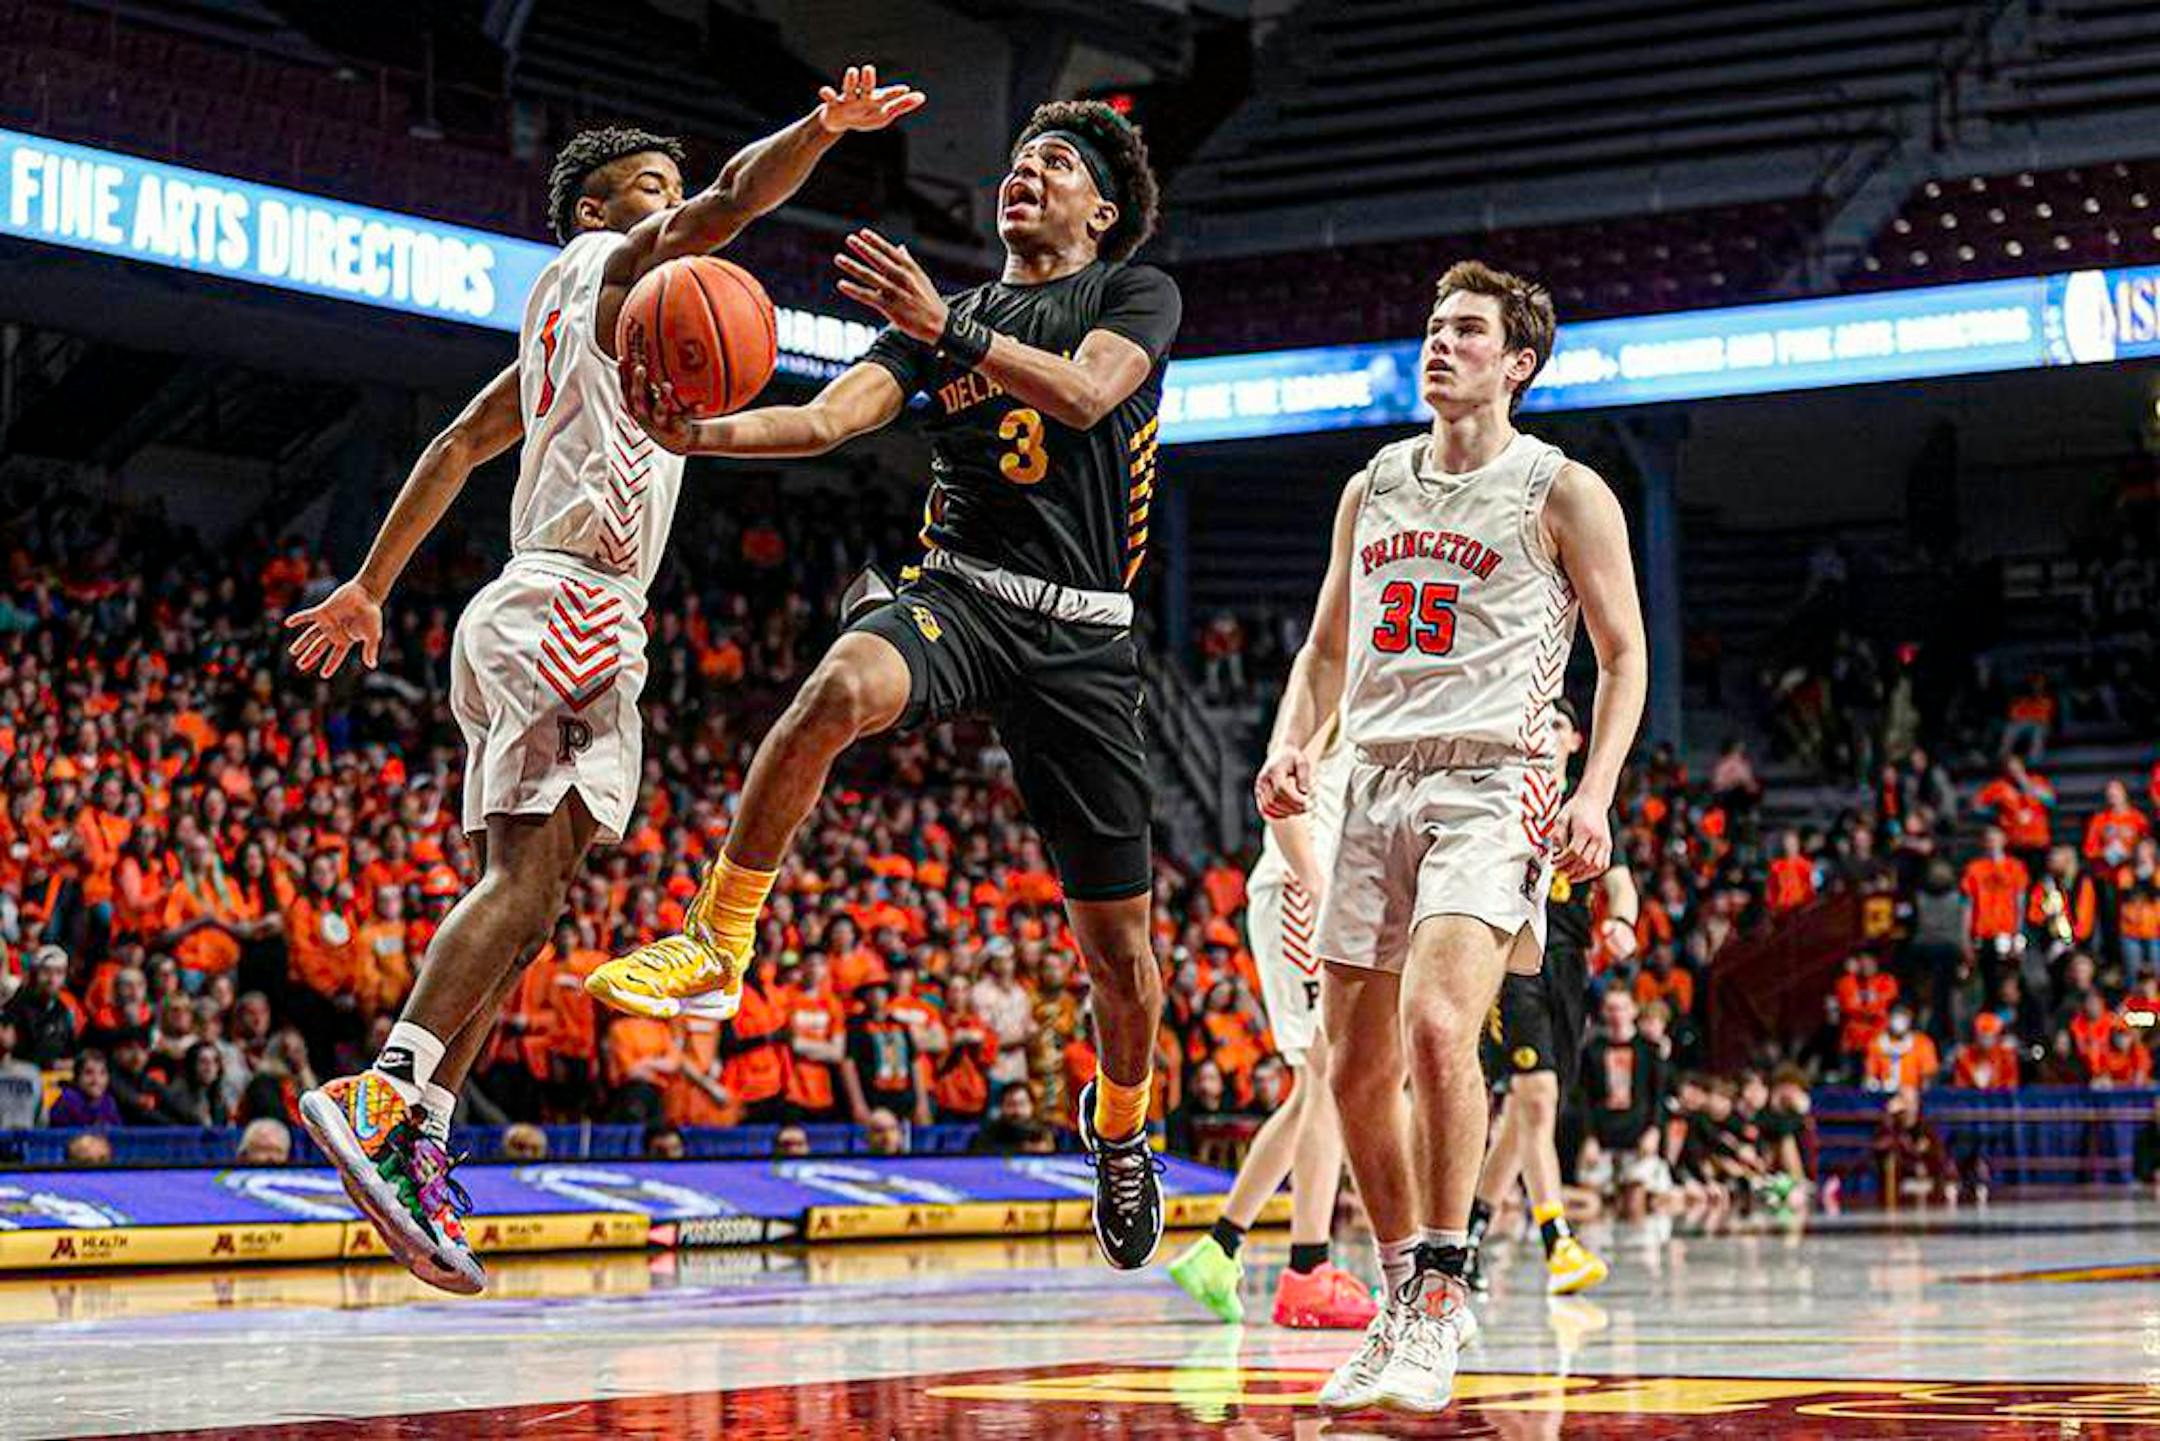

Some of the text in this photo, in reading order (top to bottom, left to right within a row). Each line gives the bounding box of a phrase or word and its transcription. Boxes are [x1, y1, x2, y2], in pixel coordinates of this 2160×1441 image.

[9, 146, 496, 317] FINE ARTS DIRECTORS
[535, 308, 562, 418] 1
[1776, 326, 1832, 365] FINE
[938, 372, 1004, 415] DELA
[999, 408, 1049, 484] 3
[1361, 530, 1503, 581] PRINCETON
[1372, 580, 1460, 656] 35
[556, 714, 593, 767] P
[1302, 981, 1319, 1012] P
